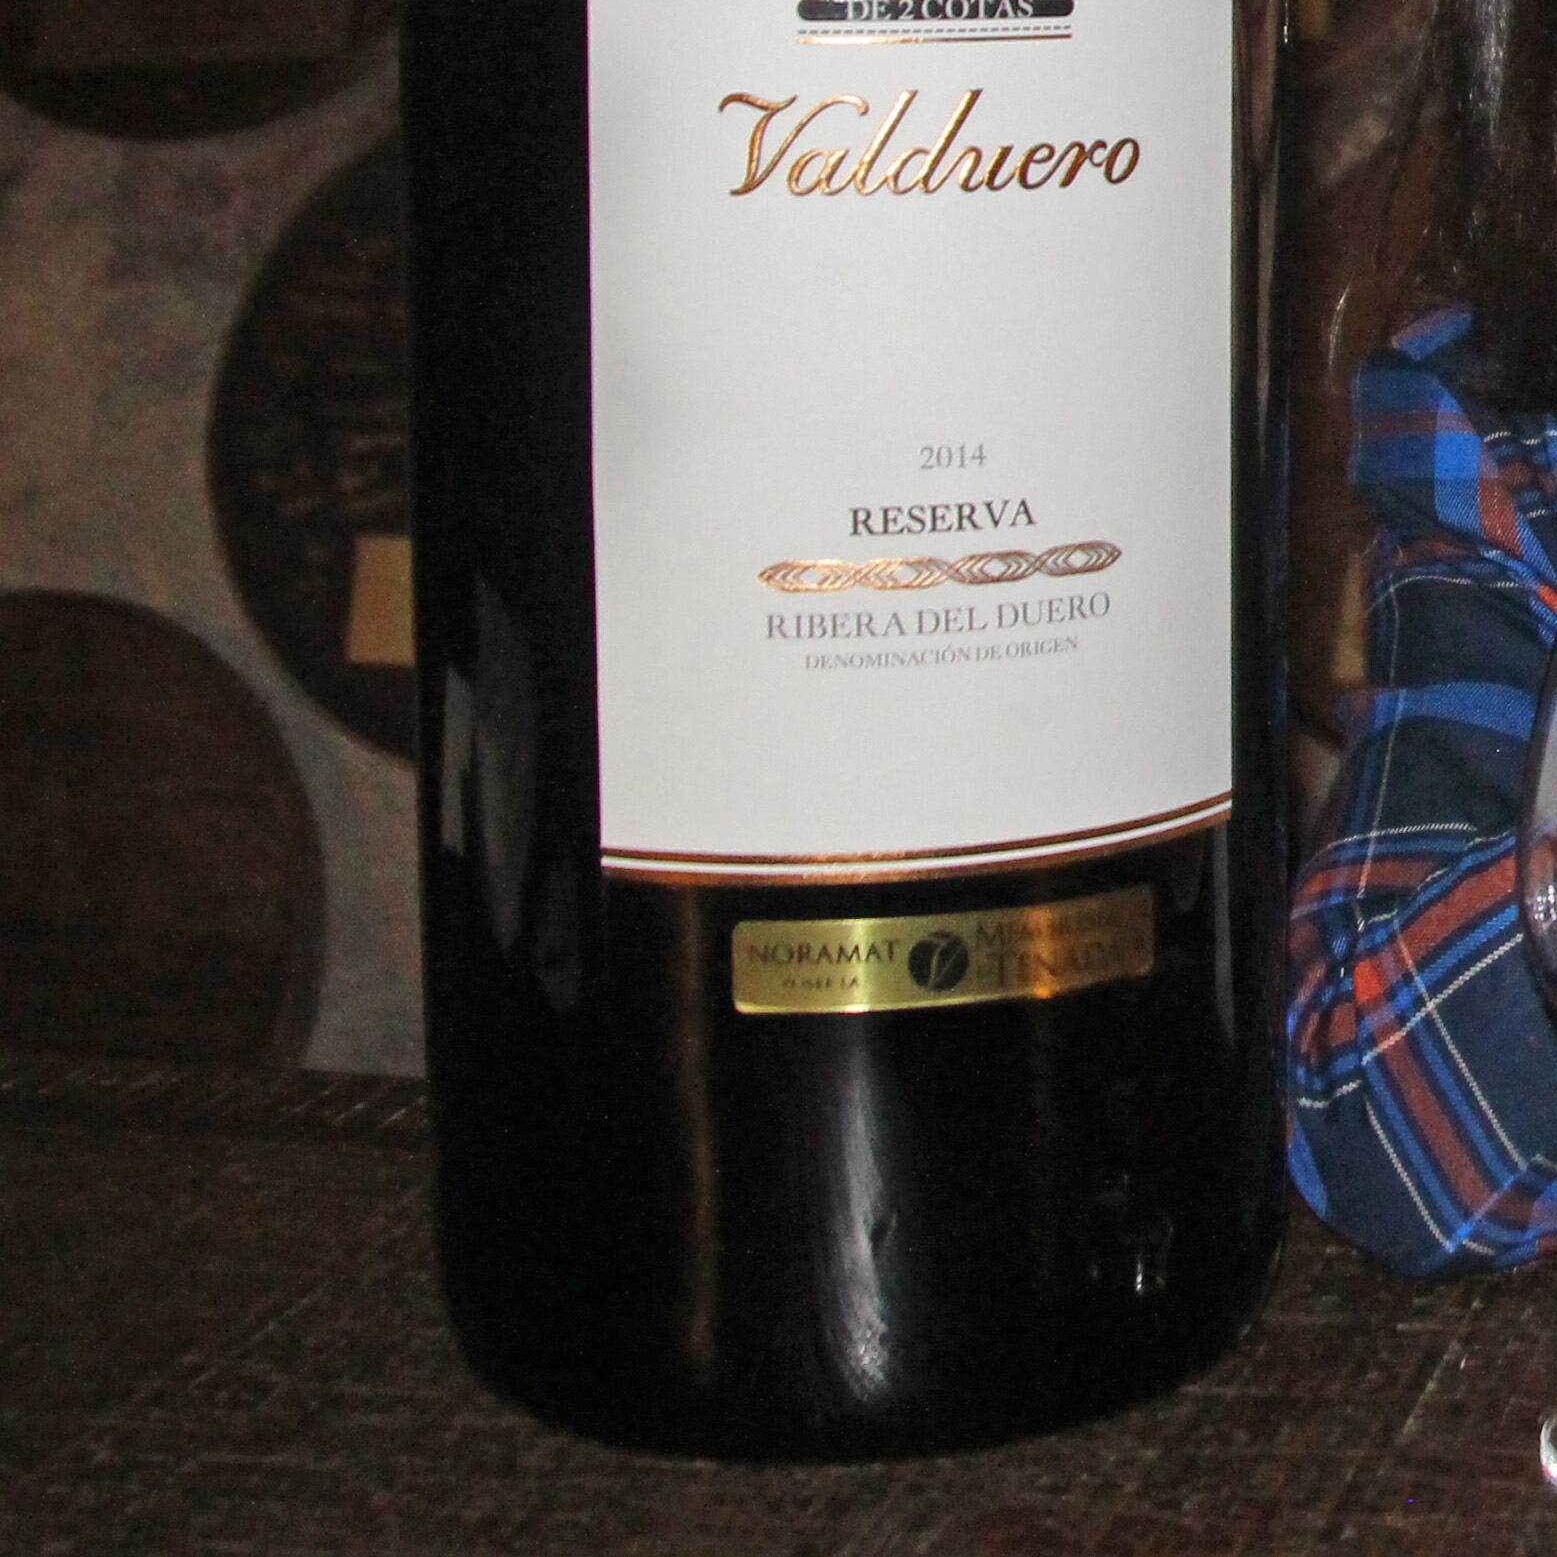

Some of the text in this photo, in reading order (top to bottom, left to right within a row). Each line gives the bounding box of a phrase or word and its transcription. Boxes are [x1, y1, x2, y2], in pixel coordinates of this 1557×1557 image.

[717, 88, 1140, 196] Valduero
[918, 443, 988, 471] 2014
[848, 497, 1038, 537] RESERVA
[765, 591, 1111, 640] RIBERA DEL DUERO
[975, 644, 1001, 662] DE
[746, 939, 899, 965] NORAMAT
